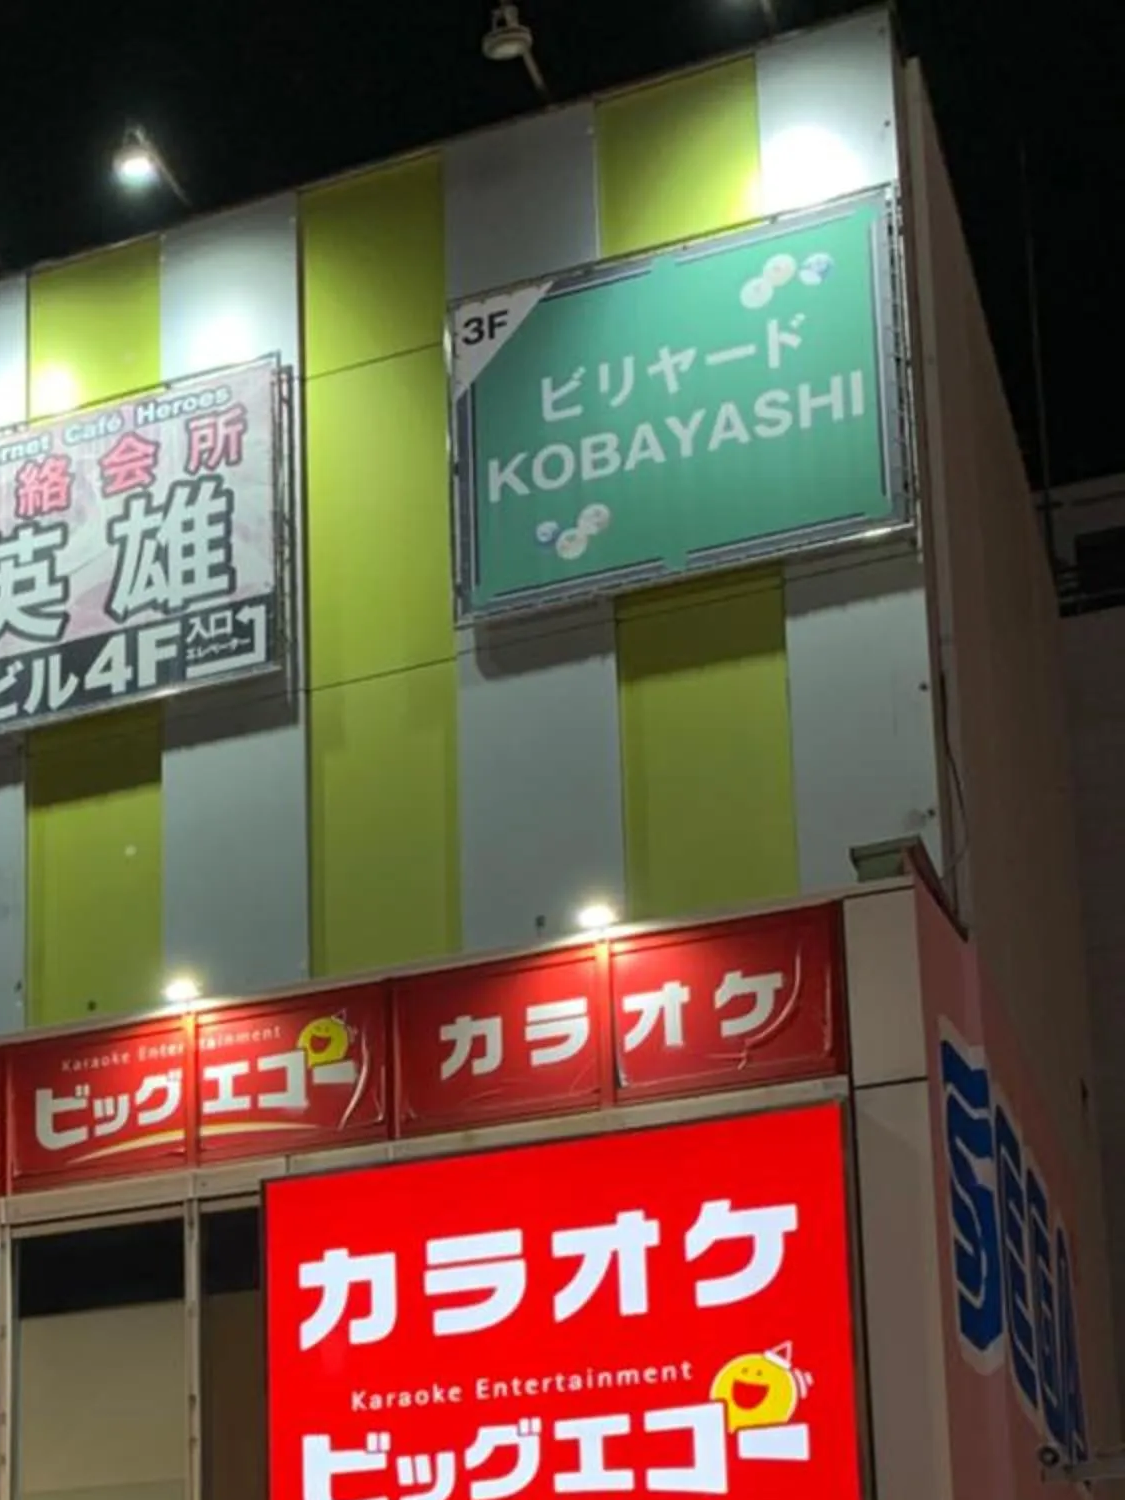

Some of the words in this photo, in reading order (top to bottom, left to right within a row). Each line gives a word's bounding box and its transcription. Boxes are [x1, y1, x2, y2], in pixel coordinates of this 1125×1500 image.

[462, 309, 509, 346] 3F
[137, 384, 232, 424] Heroes
[540, 312, 806, 422] ビリヤード
[486, 368, 865, 503] KOBAYASHI
[186, 604, 233, 643] 入口
[61, 1051, 131, 1073] Karaoke
[441, 970, 784, 1080] カラオケ
[34, 1050, 356, 1151] ビッグエコー
[298, 1199, 798, 1351] カラオケ
[350, 1383, 463, 1412] Karaoke
[475, 1361, 693, 1400] Entertainment
